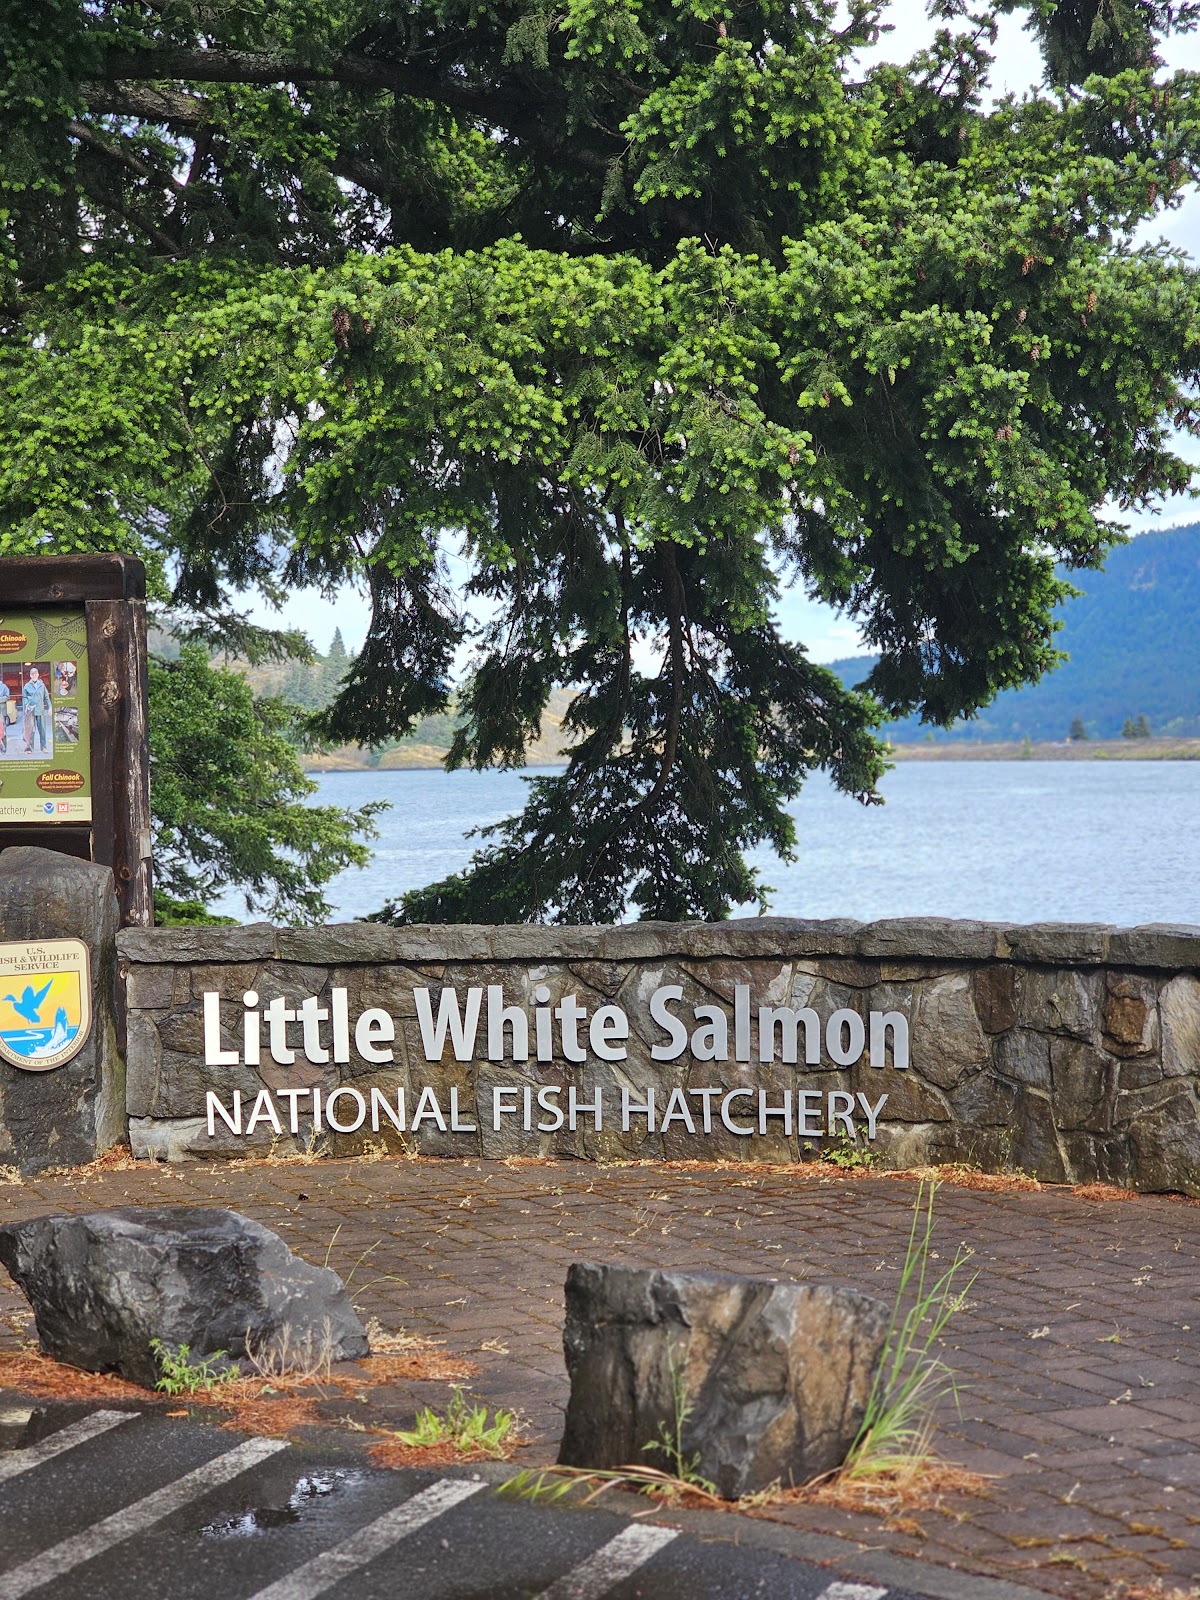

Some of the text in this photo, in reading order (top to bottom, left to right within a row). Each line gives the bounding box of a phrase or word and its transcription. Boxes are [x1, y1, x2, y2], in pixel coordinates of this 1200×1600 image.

[1, 634, 27, 642] Chinook
[54, 773, 80, 781] Chinook
[26, 947, 46, 955] U.S.
[28, 953, 80, 963] WILDLIFE
[14, 962, 60, 971] SERVICE
[203, 984, 910, 1069] Little White Salmon
[46, 1055, 61, 1065] THE
[205, 1084, 890, 1141] NATIONAL FISH HATCHERY
